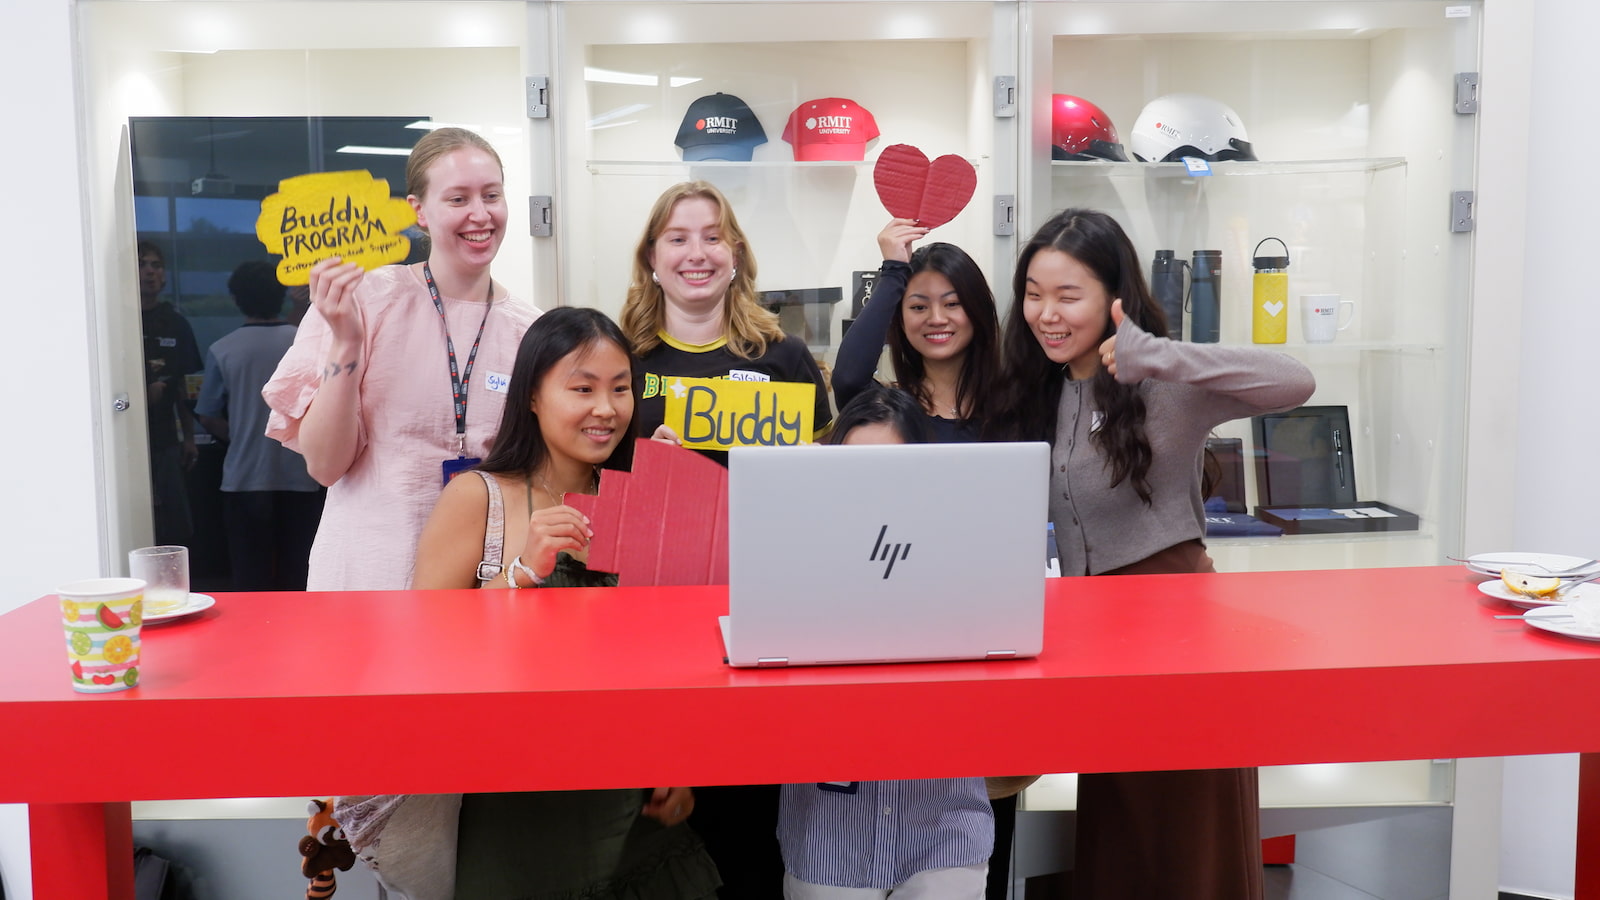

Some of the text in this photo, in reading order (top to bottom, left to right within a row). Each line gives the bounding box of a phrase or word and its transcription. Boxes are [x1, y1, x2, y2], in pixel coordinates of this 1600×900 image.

[705, 116, 738, 129] RMIT
[817, 115, 852, 128] RMIT
[280, 194, 369, 234] Buddy
[282, 218, 387, 258] PROGRAM
[684, 385, 801, 446] Buddy
[869, 524, 912, 580] hp
